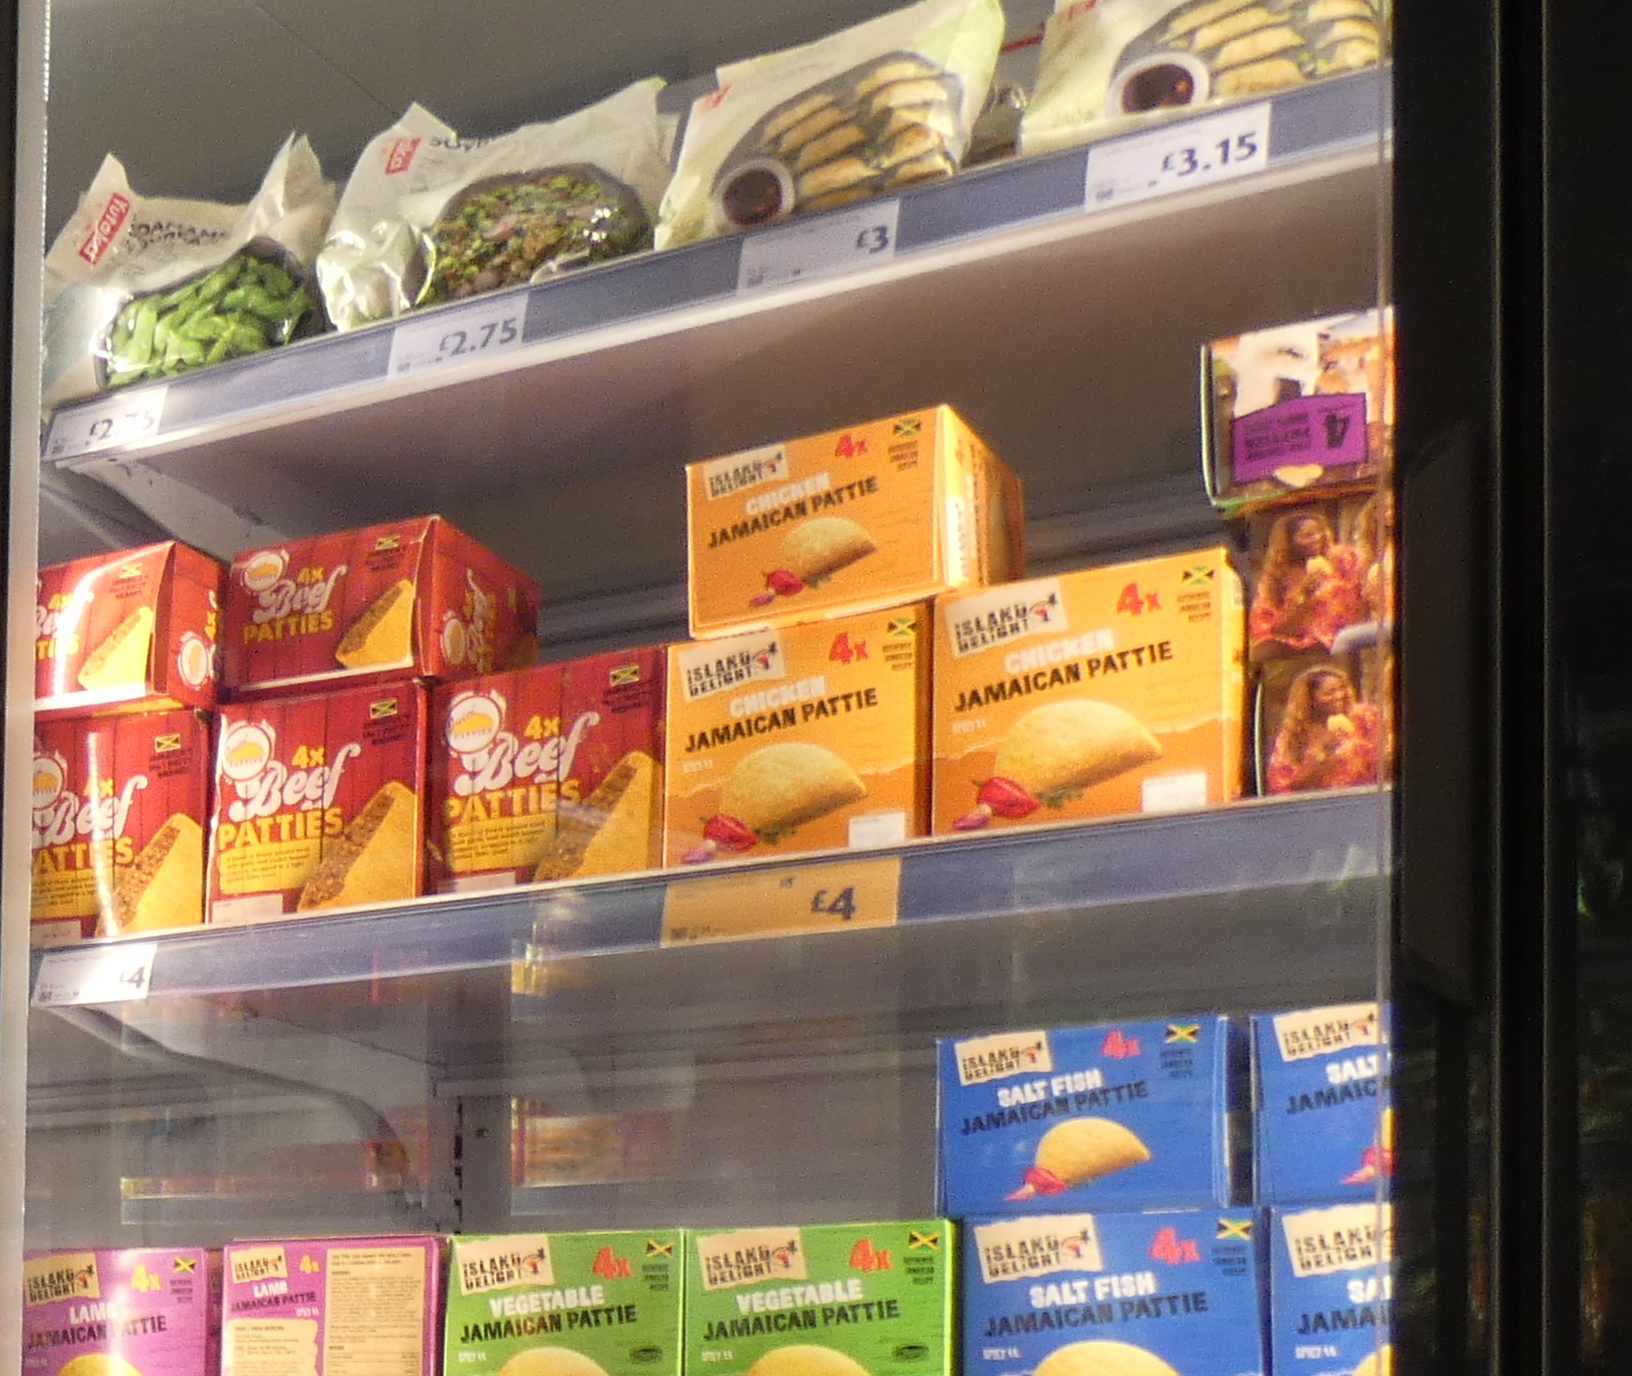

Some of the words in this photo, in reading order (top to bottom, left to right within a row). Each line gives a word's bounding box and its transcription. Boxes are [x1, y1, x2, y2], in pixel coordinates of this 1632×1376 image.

[1161, 128, 1259, 178] £3.15
[856, 223, 889, 254] £3
[439, 318, 519, 358] £2.75
[836, 434, 869, 459] 4x
[708, 498, 808, 549] JAMAICAN
[811, 474, 879, 512] PATTIE
[252, 564, 348, 624] Beef
[1116, 582, 1163, 617] 4x
[244, 609, 334, 644] PATTIES
[828, 631, 869, 665] 4x
[954, 661, 1082, 713] JAMAICAN
[1087, 640, 1174, 680] PATTIE
[524, 714, 561, 741] 4x
[685, 707, 798, 753] JAMAICAN
[802, 688, 878, 722] PATTIE
[291, 745, 325, 770] 4x
[454, 711, 601, 796] Beef
[229, 742, 361, 822] Beef
[33, 774, 148, 847] Beef
[447, 779, 583, 824] PATTIES
[218, 808, 345, 851] PATTIES
[33, 836, 134, 875] ATTIES
[811, 886, 856, 921] £4
[1100, 1030, 1141, 1060] 4x
[1326, 1053, 1378, 1084] SALT
[997, 1077, 1048, 1107] SALT
[1052, 1068, 1103, 1098] FISH
[959, 1098, 1071, 1136] JAMAICAN
[1074, 1081, 1149, 1114] PATTIE
[299, 1254, 320, 1274] 4x
[592, 1246, 631, 1281] 4x
[849, 1237, 893, 1273] 4x
[1149, 1227, 1202, 1265] 4x
[131, 1263, 162, 1294] 4x
[253, 1280, 288, 1298] LAMB
[736, 1278, 864, 1314] VEGETABLE
[1029, 1279, 1089, 1309] SALT
[1094, 1271, 1158, 1300] FISH
[69, 1302, 126, 1325] LAMB
[282, 1291, 316, 1307] PATTIE
[489, 1285, 605, 1318] VEGETABLE
[983, 1306, 1115, 1338] JAMAICAN
[1122, 1292, 1210, 1321] PATTIE
[27, 1321, 107, 1350] JAMAICAN
[110, 1315, 167, 1340] ATTIE
[460, 1314, 563, 1344] JAMAICAN
[567, 1304, 637, 1331] PATTIE
[703, 1311, 818, 1341] JAMAICAN
[821, 1299, 901, 1327] PATTIE
